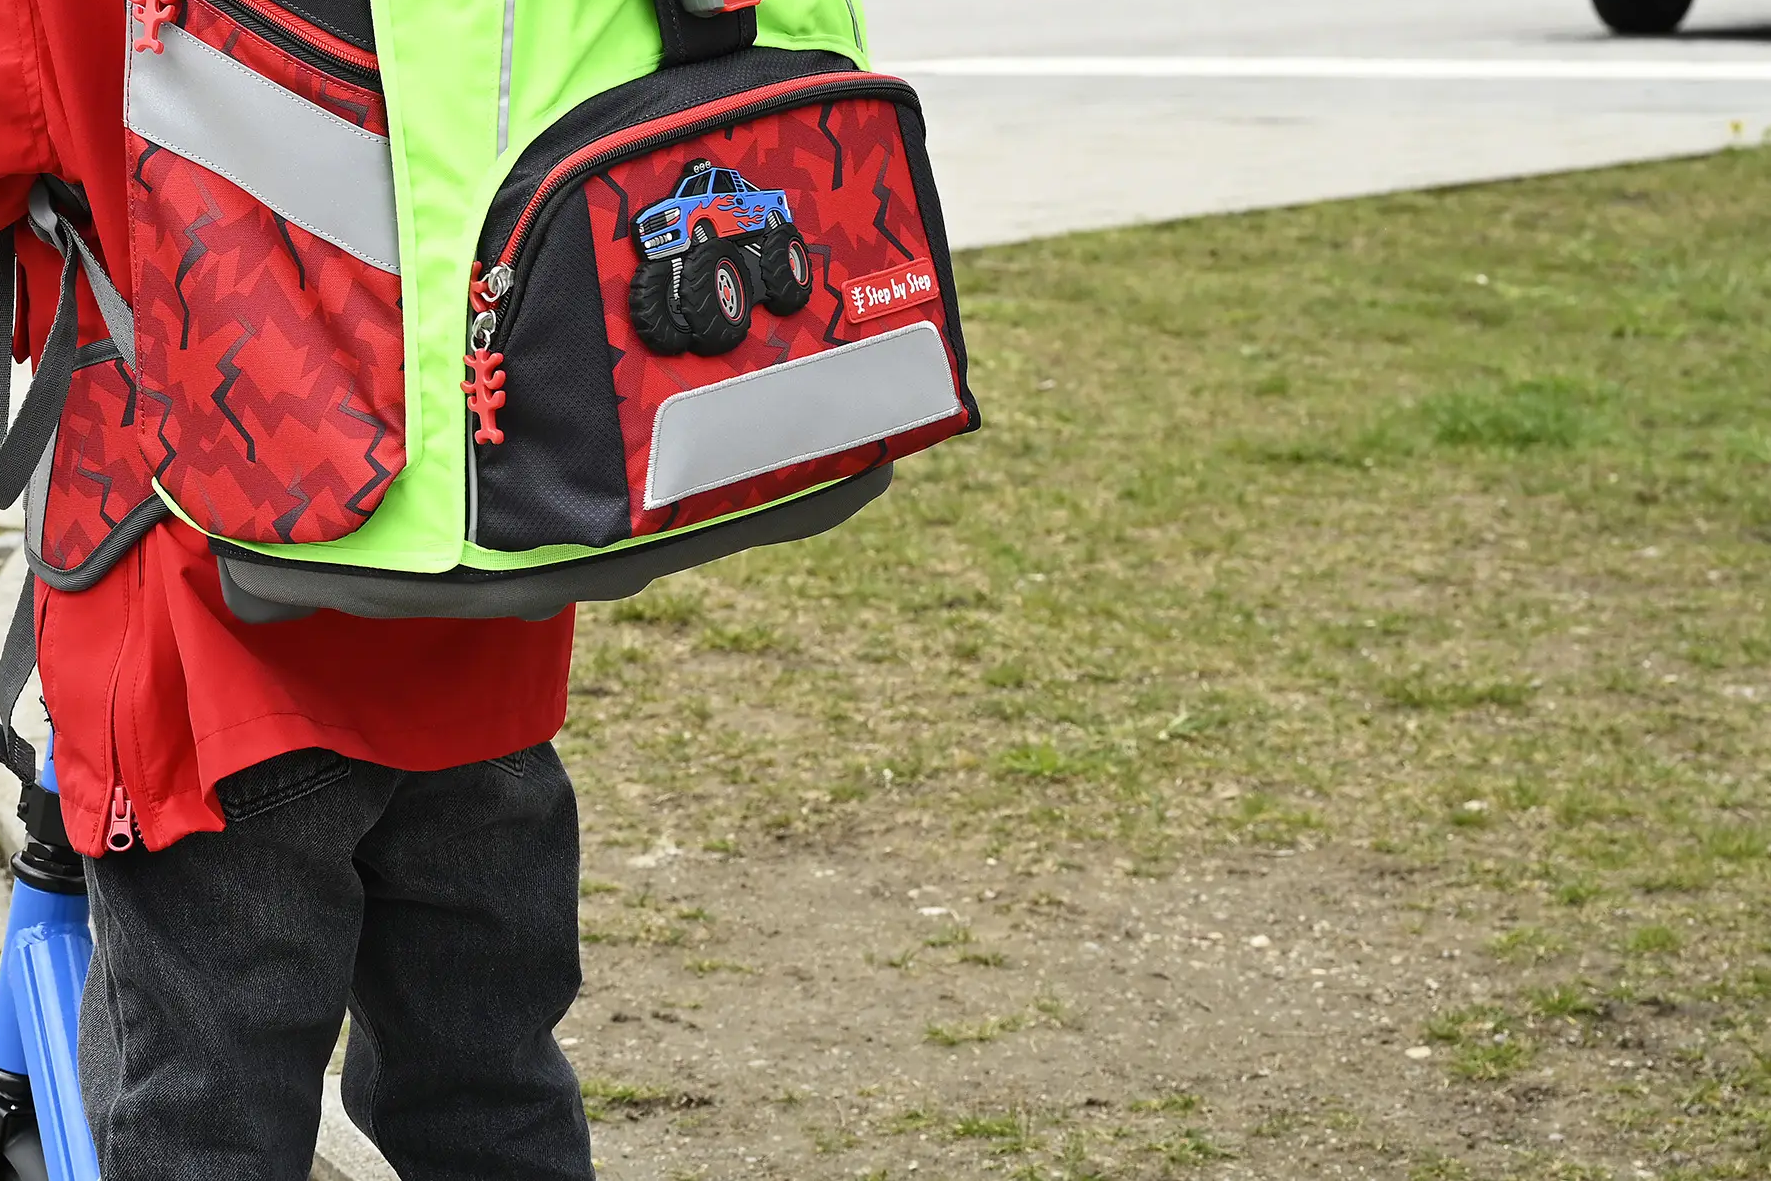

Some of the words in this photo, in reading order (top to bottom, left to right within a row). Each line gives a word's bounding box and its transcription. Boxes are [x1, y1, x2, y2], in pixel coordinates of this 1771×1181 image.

[865, 285, 891, 307] Step
[890, 278, 907, 300] by
[906, 272, 931, 294] Step
